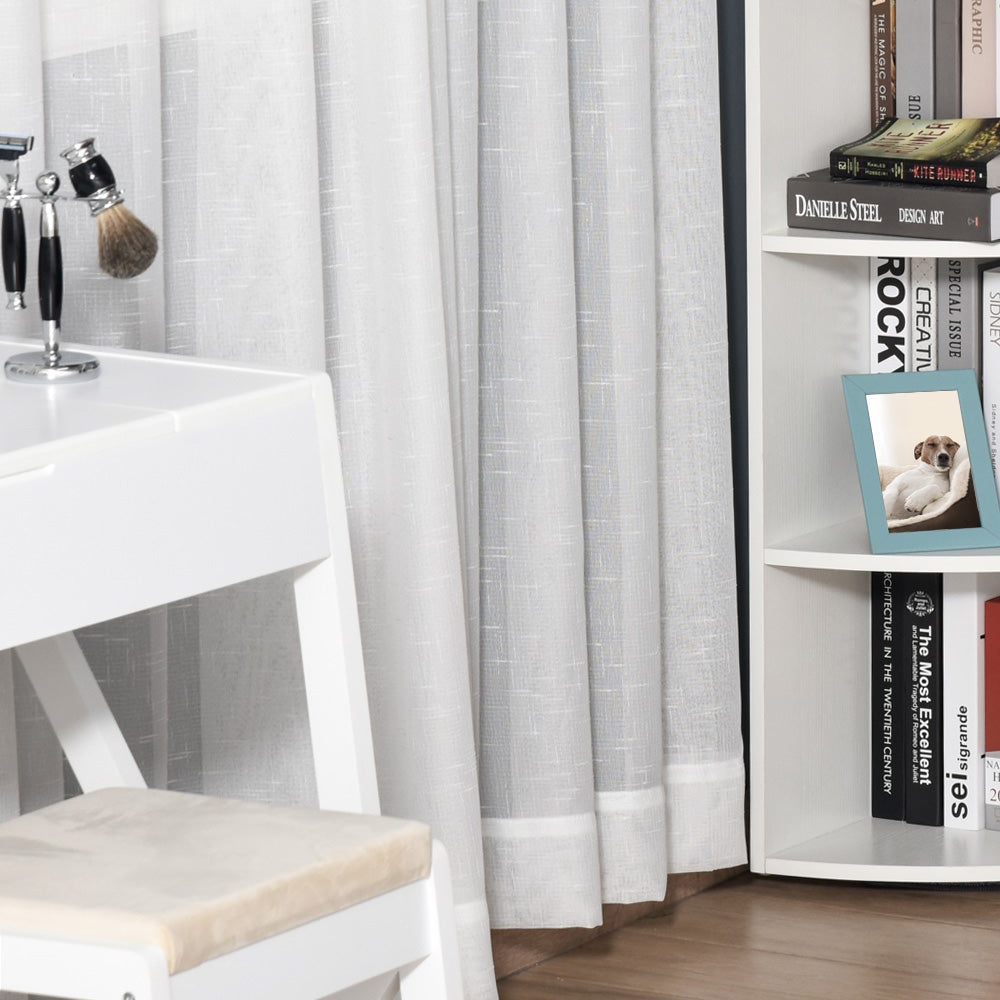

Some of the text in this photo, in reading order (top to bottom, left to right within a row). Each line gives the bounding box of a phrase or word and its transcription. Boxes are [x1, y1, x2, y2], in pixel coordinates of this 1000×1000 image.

[878, 14, 887, 121] THE MAGIC OF SH
[908, 95, 921, 120] SUE
[913, 164, 935, 180] KITE
[937, 165, 977, 183] RUNNER
[795, 194, 882, 223] DANIELLE STEEL
[898, 208, 944, 226] DESIGN ART
[877, 257, 906, 373] ROCK
[916, 287, 931, 372] CREATIV
[948, 260, 961, 359] SPECIAL ISSUE
[989, 291, 1000, 348] SIDNEY
[883, 572, 893, 795] RCHITECTURE IN THE TWENTIETH CENTURY
[911, 684, 919, 712] Tragedy
[919, 625, 932, 785] The Most Excellent
[912, 713, 918, 721] of
[946, 773, 968, 820] sei
